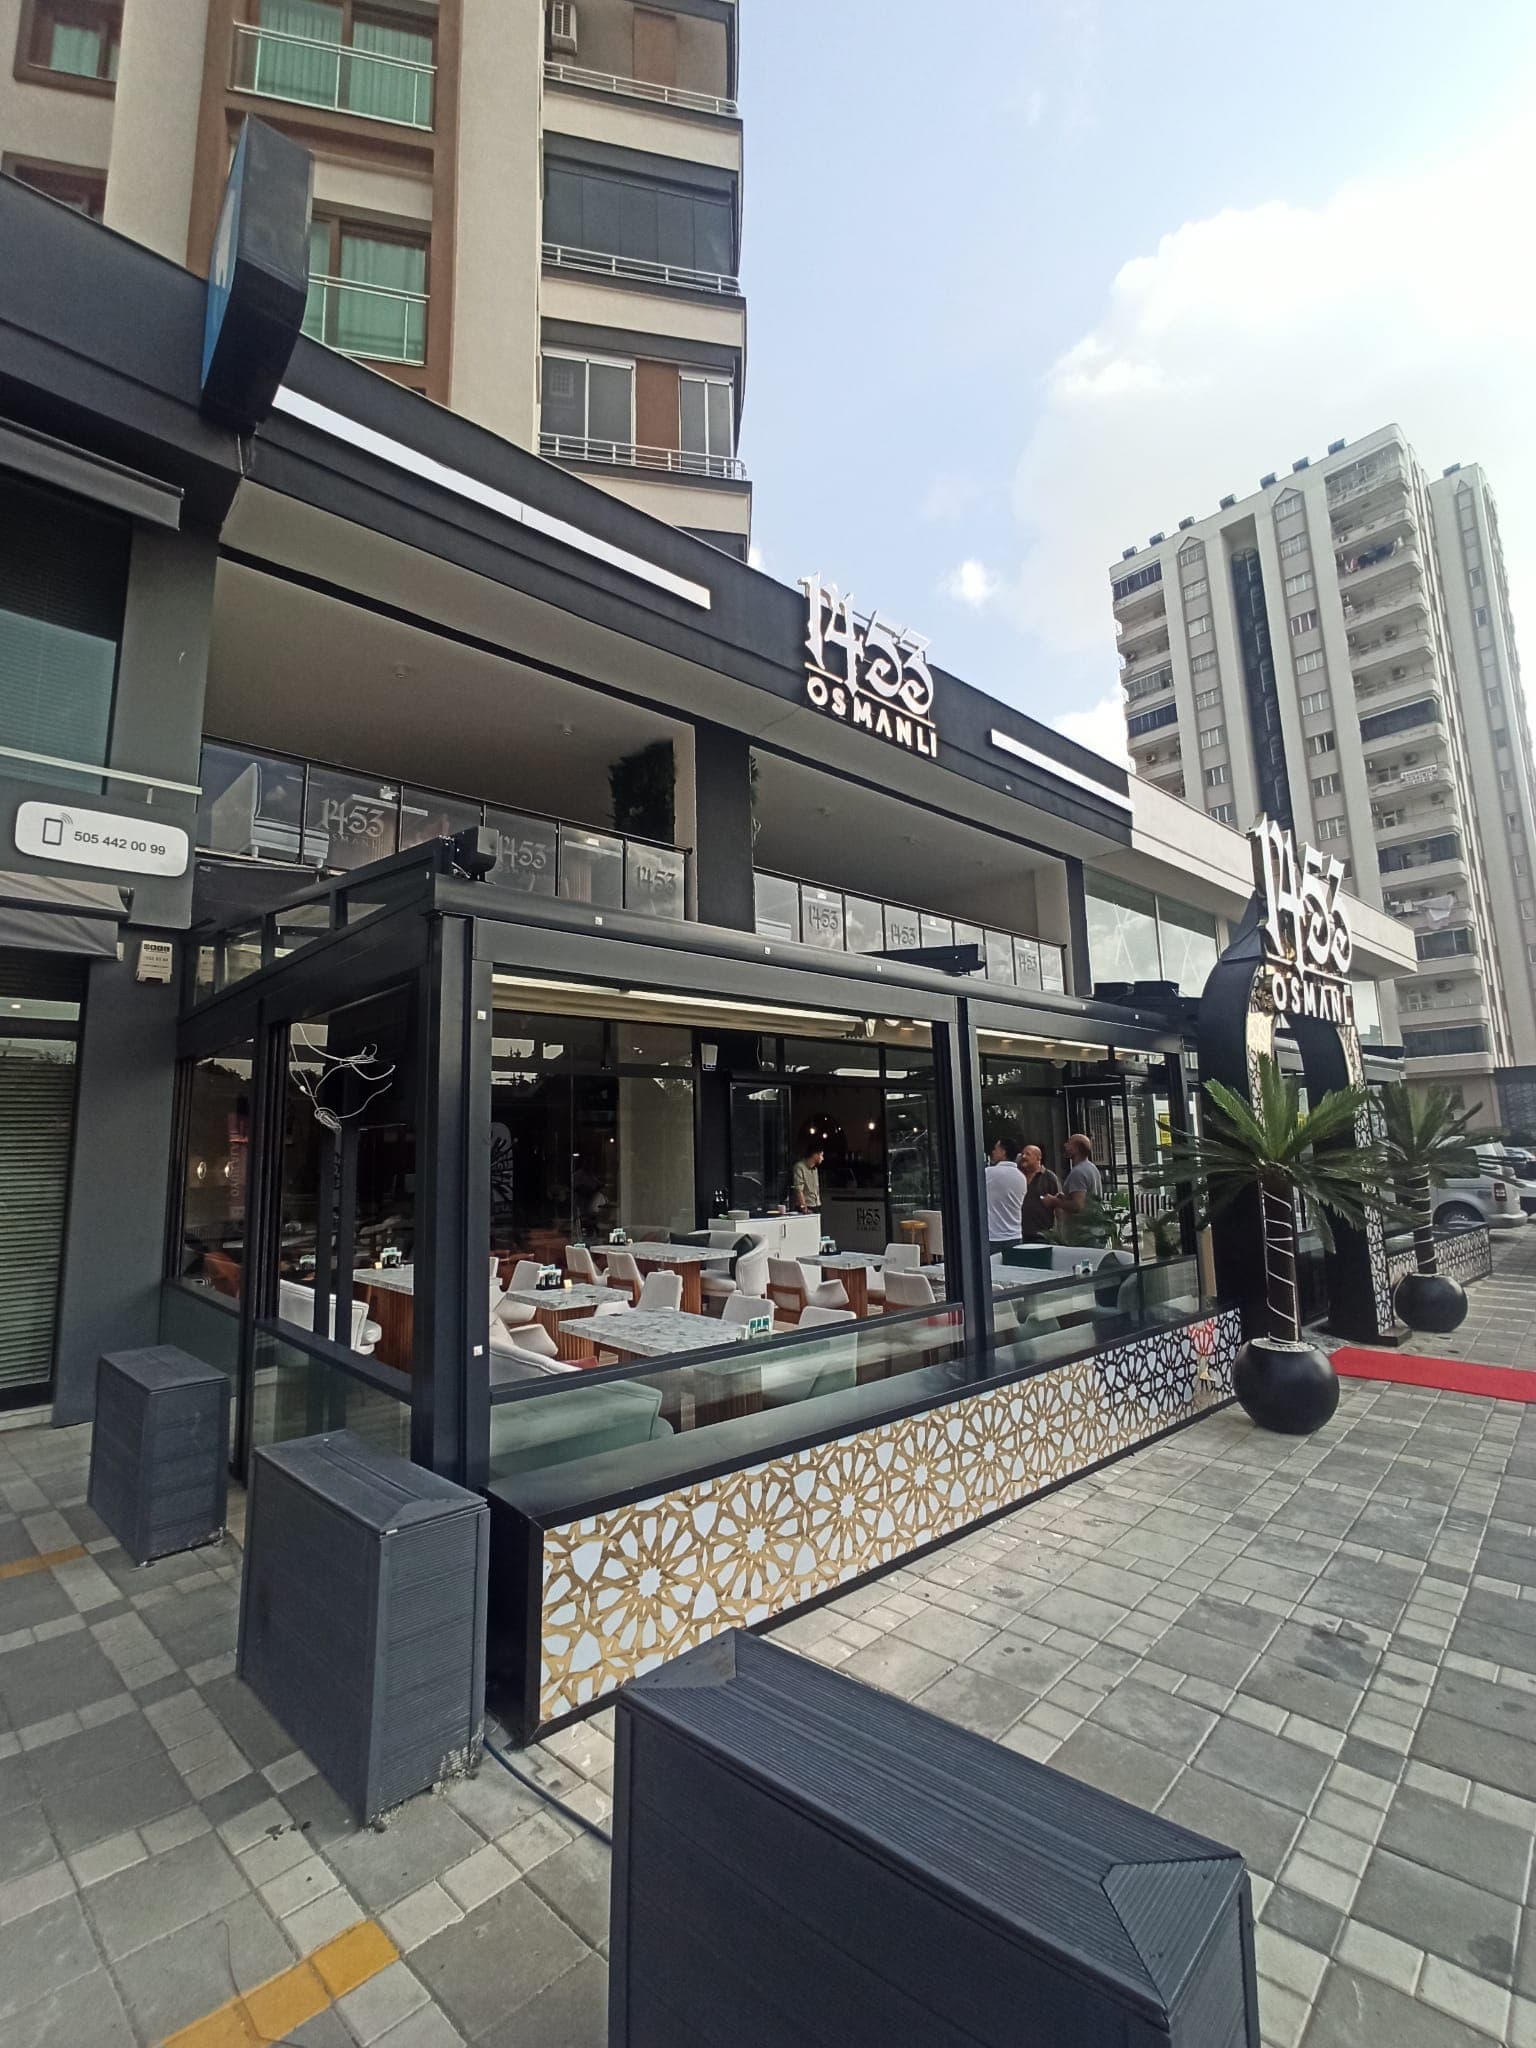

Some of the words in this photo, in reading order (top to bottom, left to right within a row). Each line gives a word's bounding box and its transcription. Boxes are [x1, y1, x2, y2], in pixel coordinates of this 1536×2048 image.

[798, 571, 934, 715] 1453
[807, 676, 937, 758] OSMANLI
[320, 798, 385, 839] 1453
[74, 831, 99, 844] 505
[102, 836, 127, 849] 442
[131, 841, 147, 853] 00
[150, 844, 166, 856] 99
[499, 834, 546, 872] 1453
[1248, 812, 1353, 980] 1453
[808, 904, 839, 930] 1453
[890, 923, 916, 946] 1453
